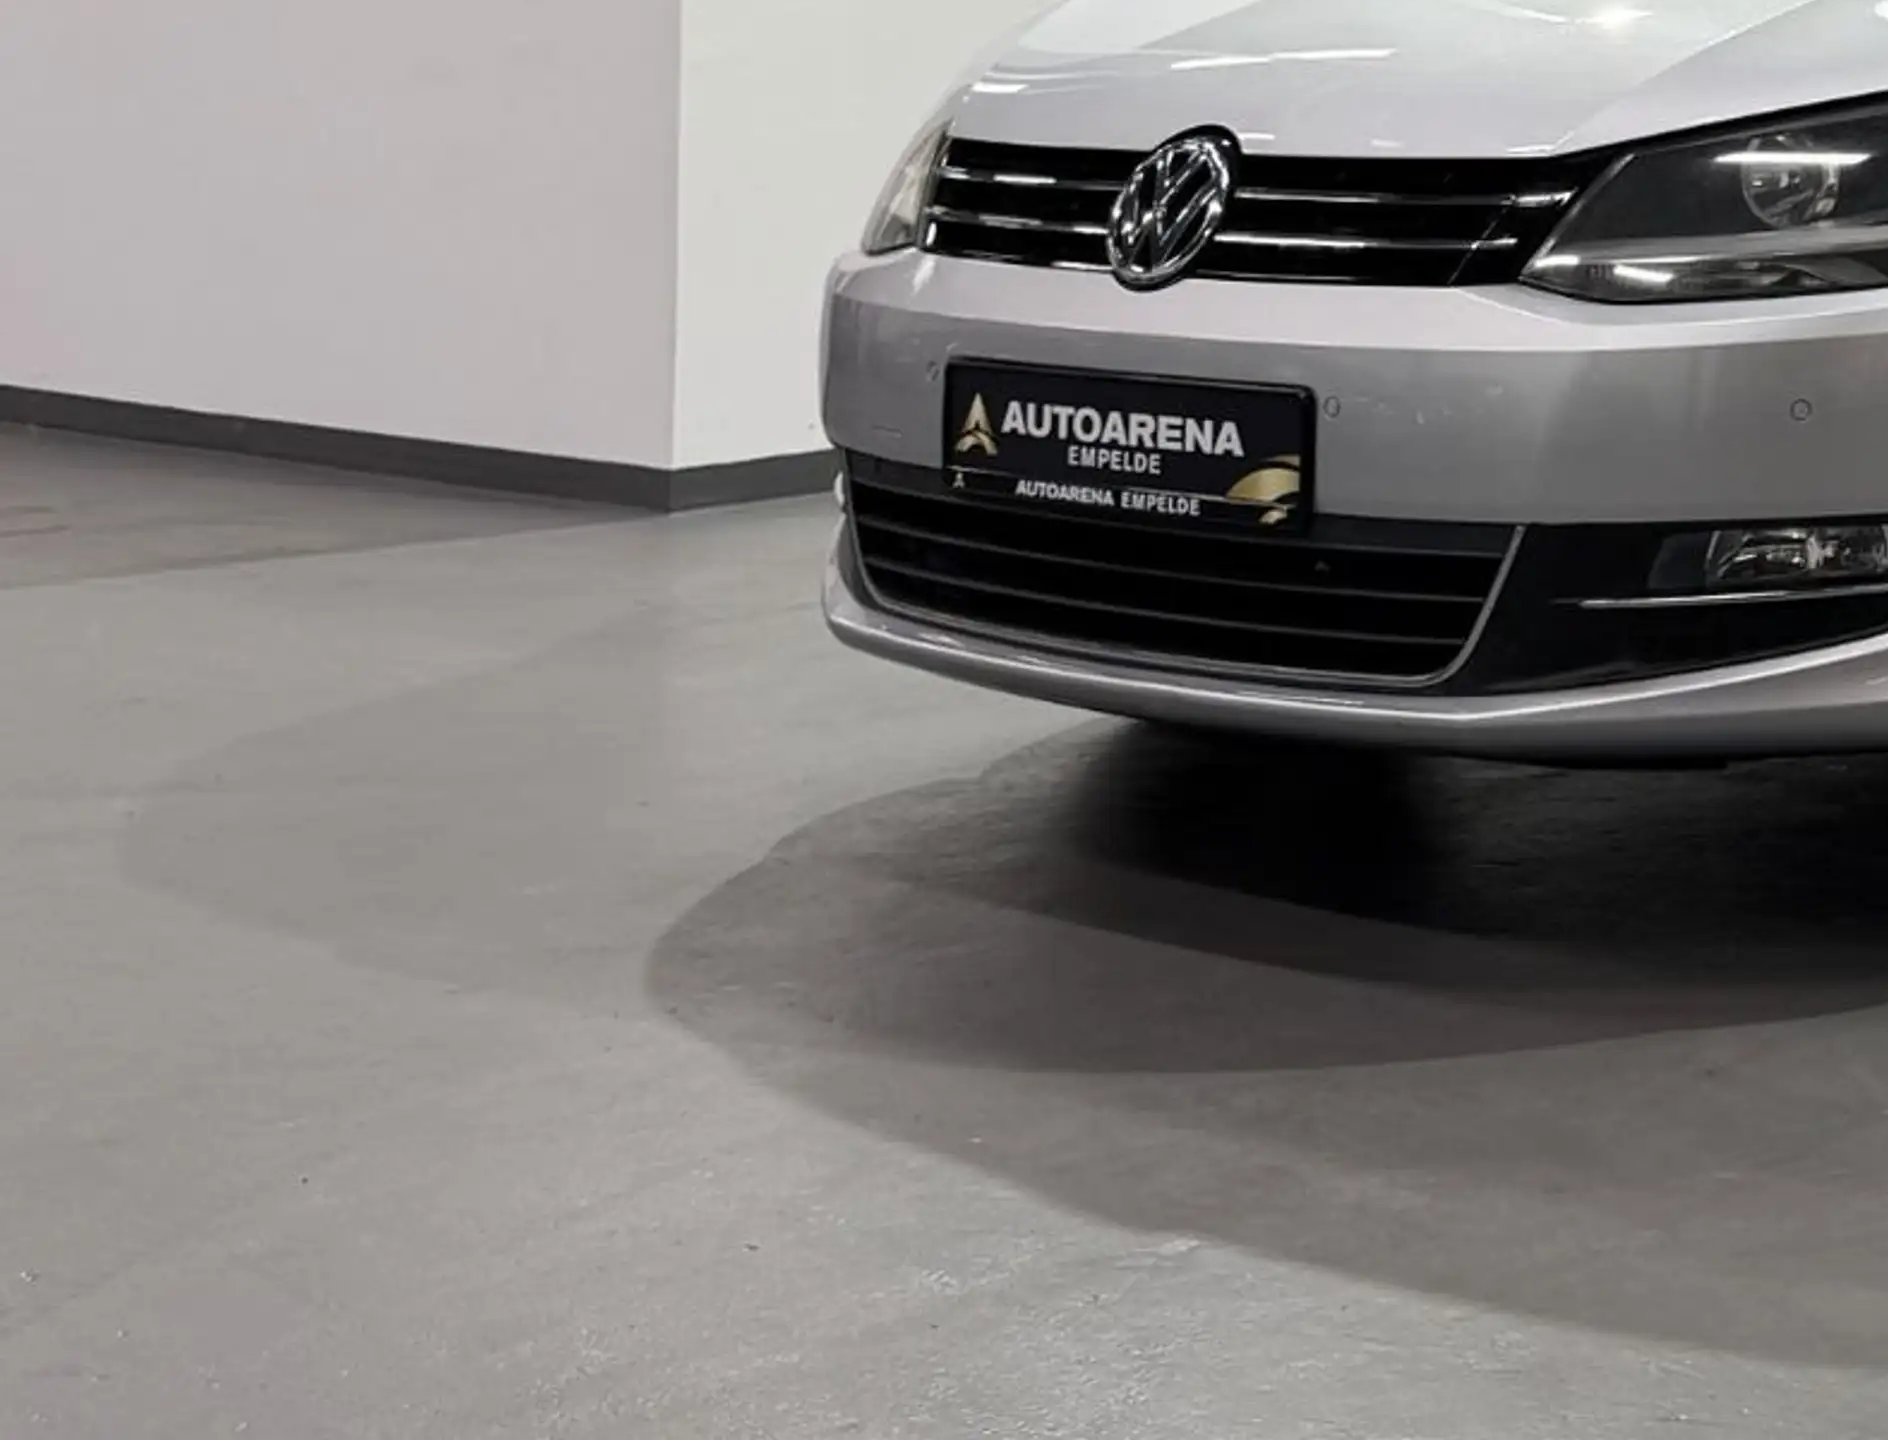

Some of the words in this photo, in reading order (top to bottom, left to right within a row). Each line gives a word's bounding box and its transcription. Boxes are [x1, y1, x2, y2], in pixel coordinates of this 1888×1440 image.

[1001, 399, 1245, 457] AUTOARENA
[1067, 444, 1162, 475] EMPELDE
[1014, 478, 1115, 507] AUTOARENA
[1120, 490, 1201, 517] EMPELDE
